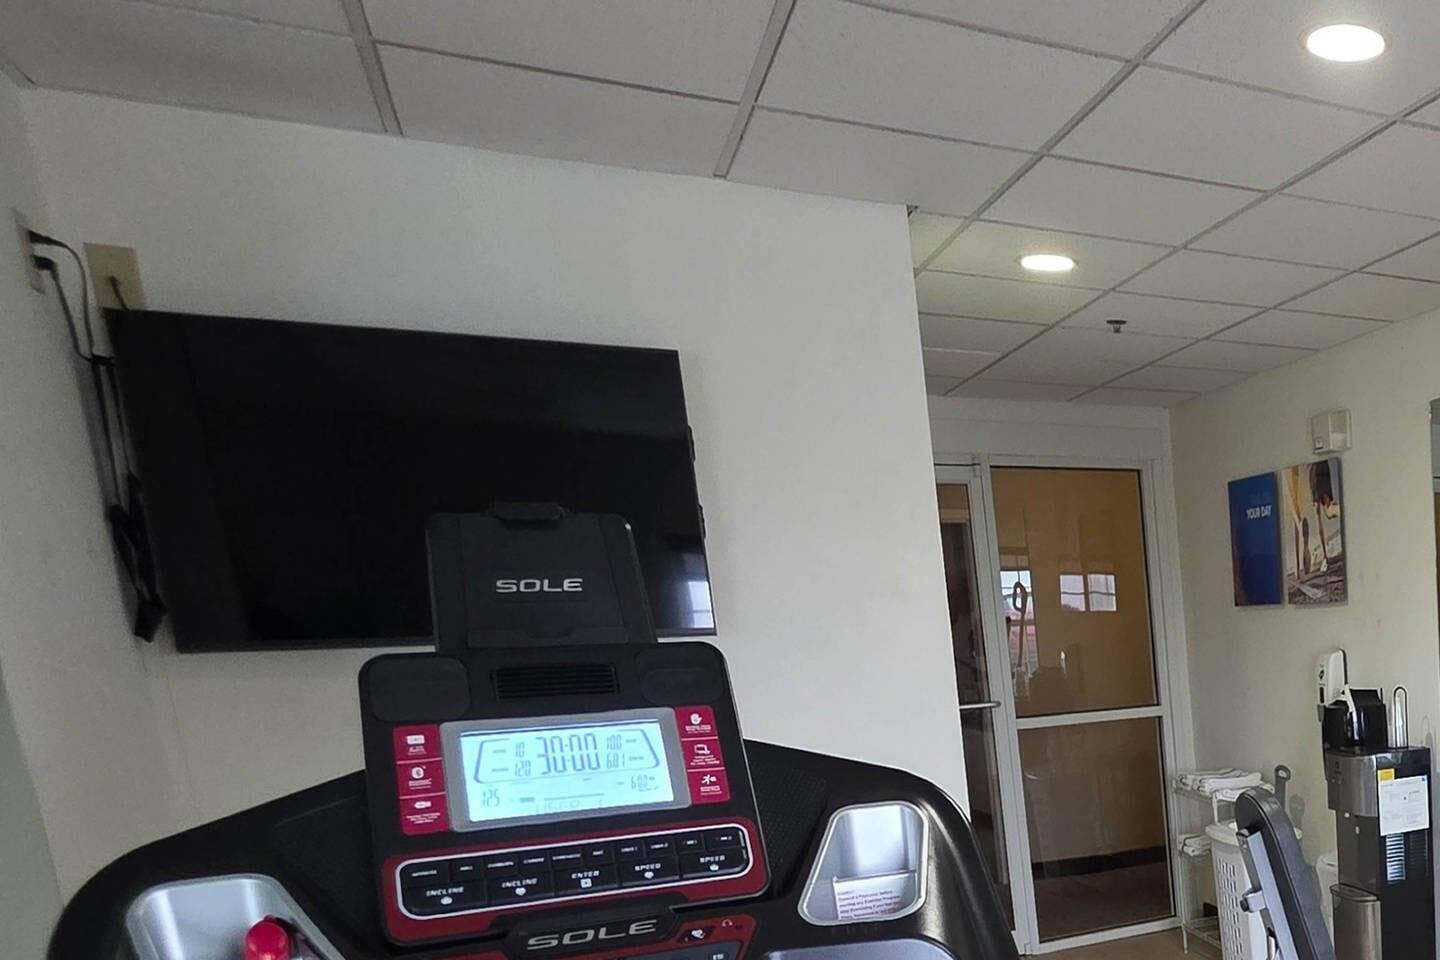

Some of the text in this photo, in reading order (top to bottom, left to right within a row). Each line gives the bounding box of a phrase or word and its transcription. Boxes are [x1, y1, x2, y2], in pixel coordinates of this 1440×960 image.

[495, 578, 584, 593] SOLE
[536, 733, 601, 775] 30:00
[501, 877, 538, 888] INCLINE
[426, 886, 465, 897] INCLINE
[527, 920, 657, 950] SOLE
